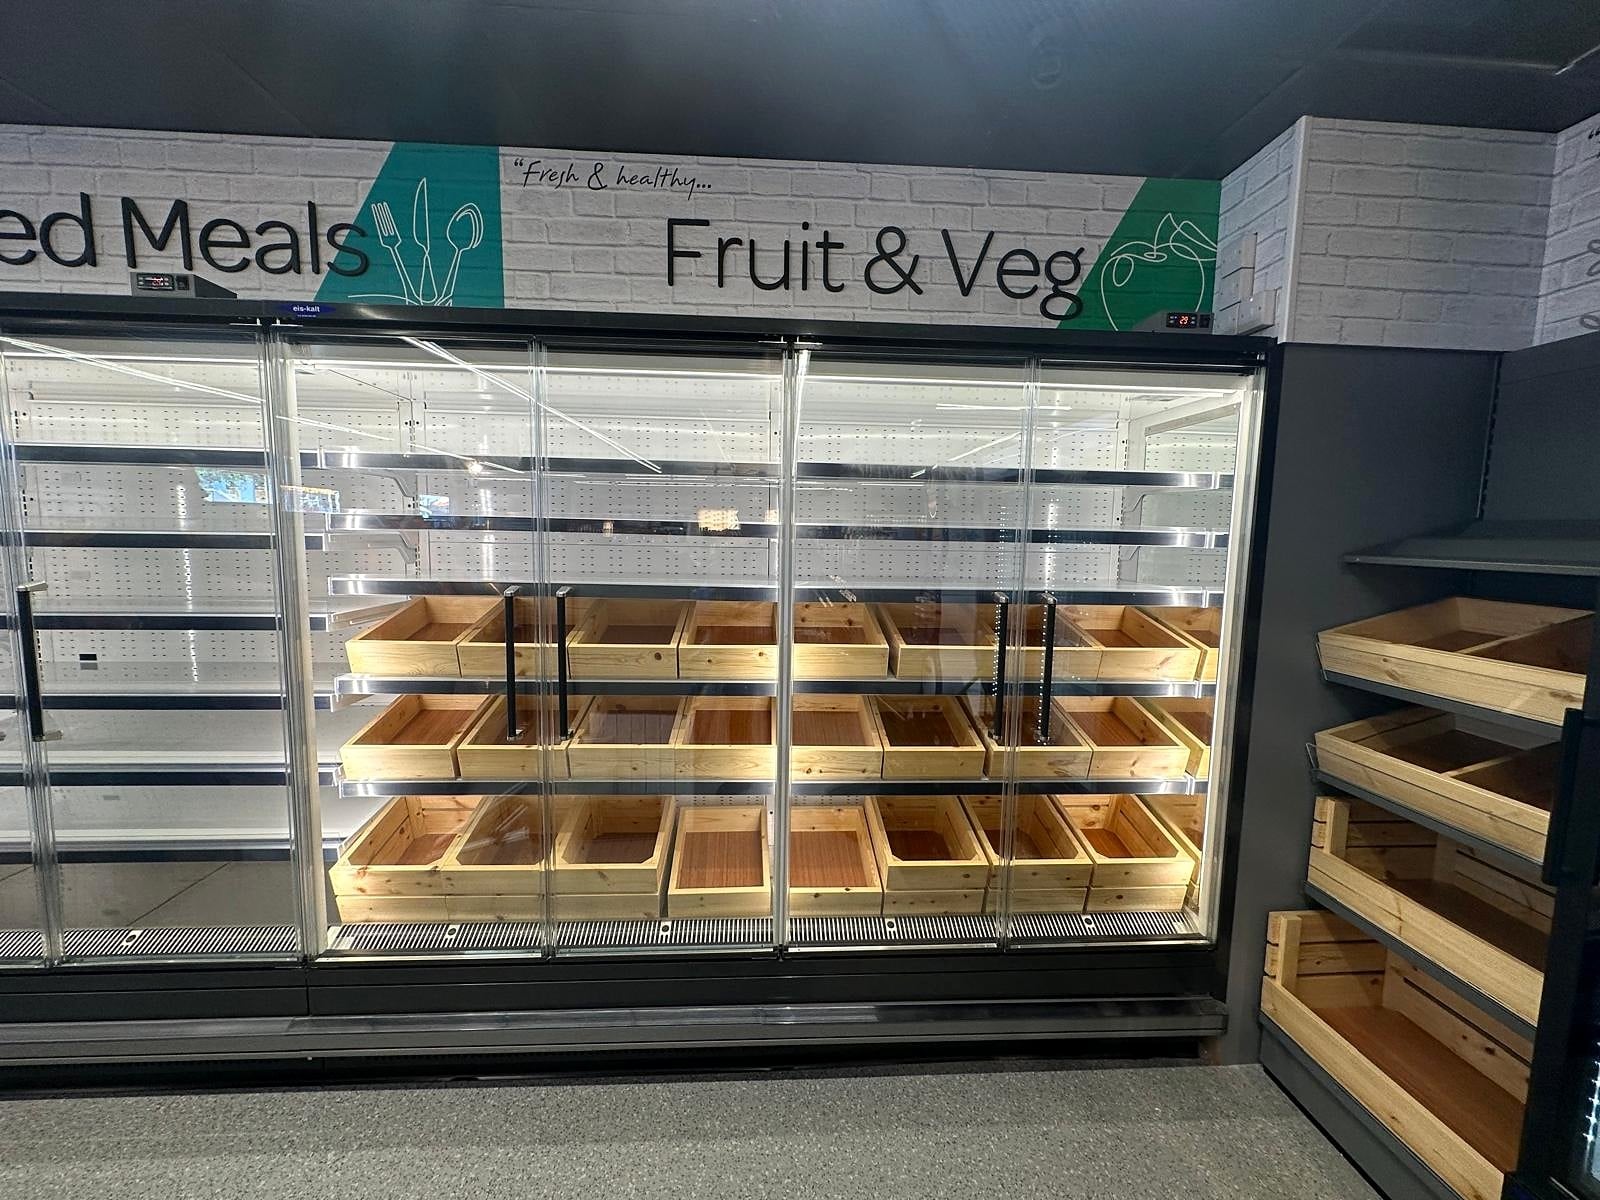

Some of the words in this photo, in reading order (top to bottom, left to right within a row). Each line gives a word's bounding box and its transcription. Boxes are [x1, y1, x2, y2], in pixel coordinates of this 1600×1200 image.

[587, 162, 608, 190] &
[616, 165, 712, 200] healthy...
[121, 196, 369, 276] Meals
[667, 217, 845, 293] Fruit
[863, 225, 924, 296] &
[940, 229, 1084, 320] Veg
[292, 304, 321, 313] eis-kalt
